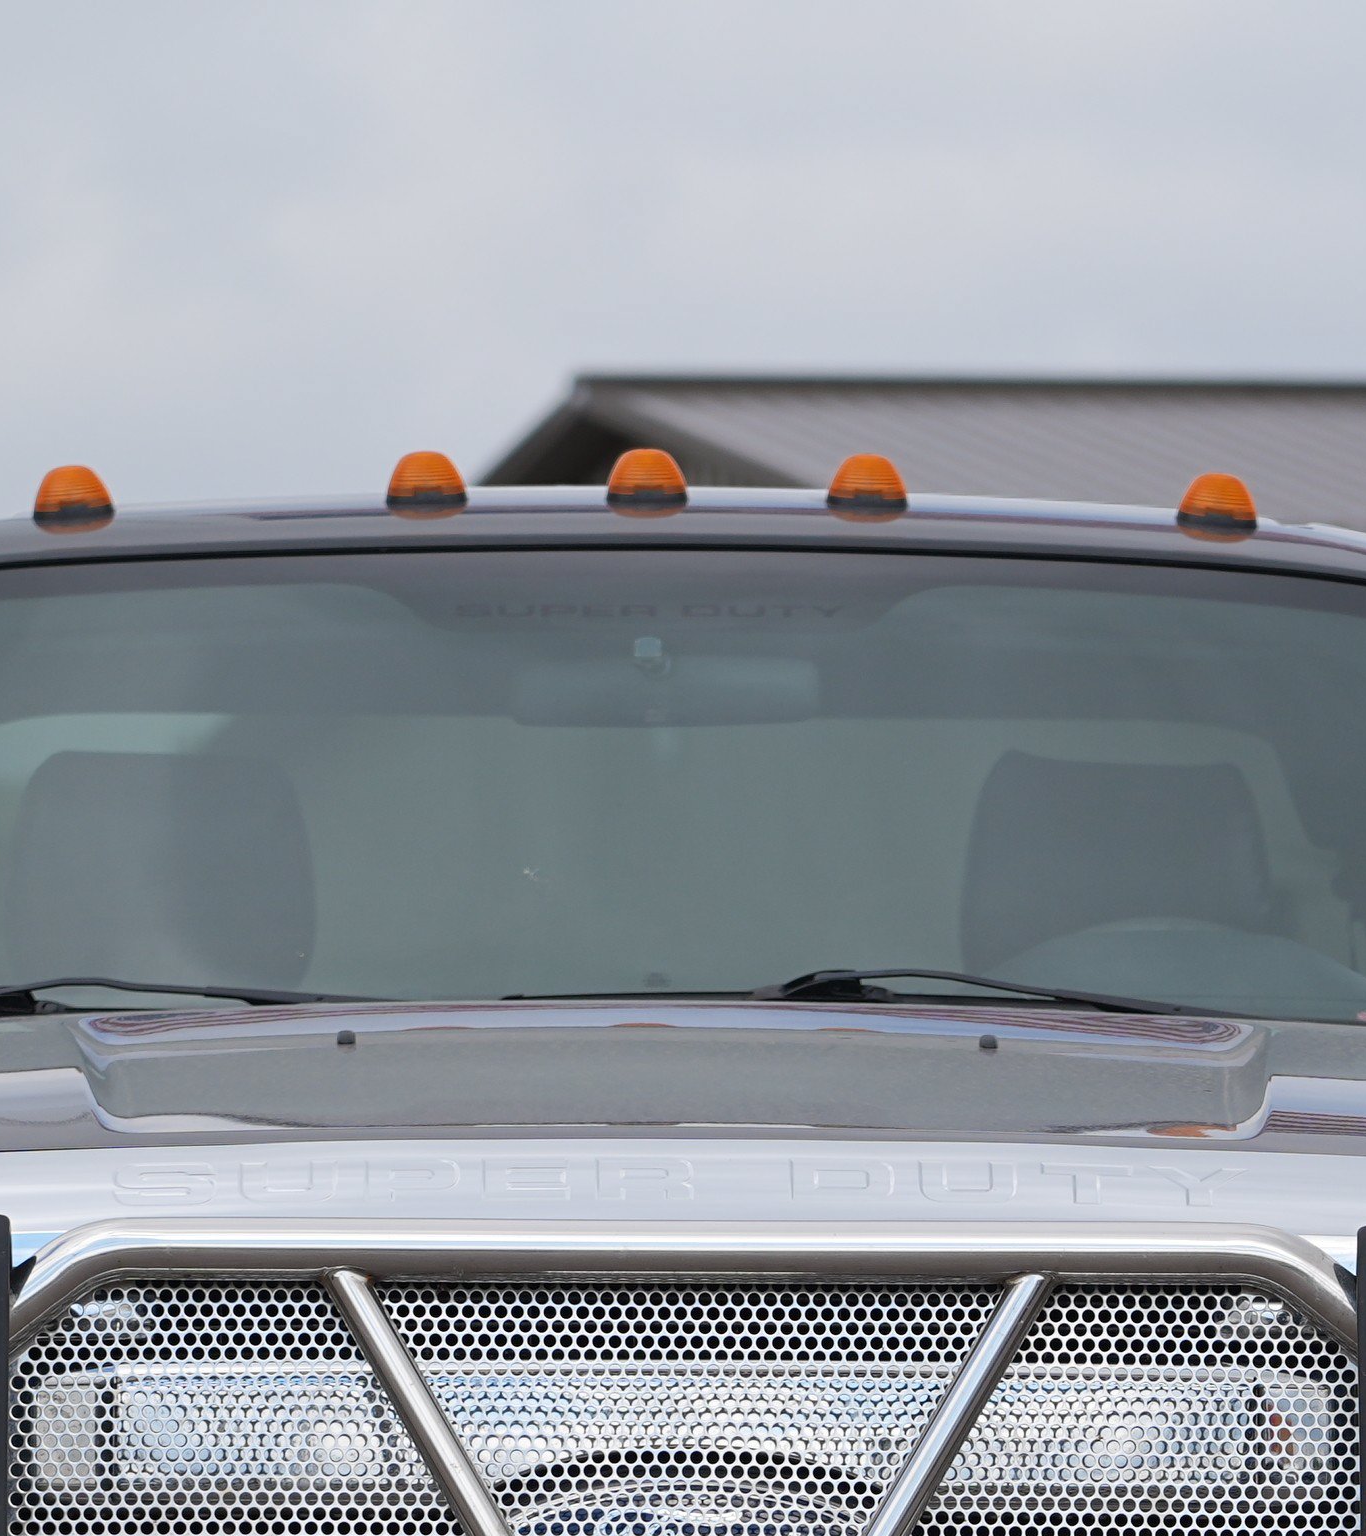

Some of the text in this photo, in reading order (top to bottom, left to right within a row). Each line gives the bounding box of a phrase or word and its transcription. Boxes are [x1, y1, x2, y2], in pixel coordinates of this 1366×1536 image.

[452, 603, 844, 618] SUPER DUTY
[111, 1158, 1249, 1207] SUPER DUTY
